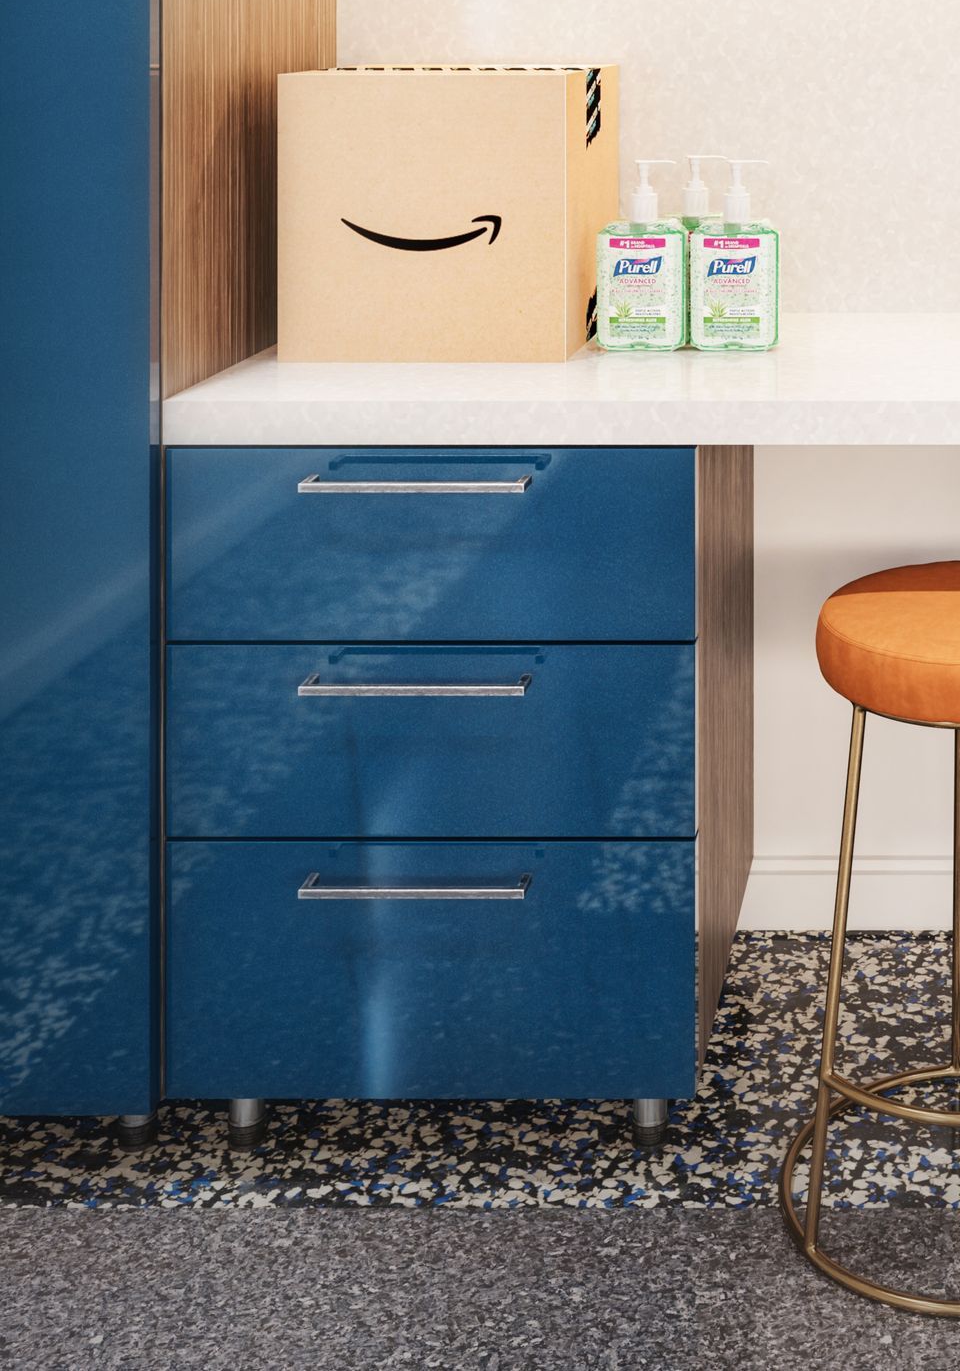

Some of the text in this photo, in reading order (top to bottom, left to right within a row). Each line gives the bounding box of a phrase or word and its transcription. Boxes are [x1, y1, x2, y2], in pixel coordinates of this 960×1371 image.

[620, 240, 630, 248] #1
[714, 240, 724, 248] #1
[619, 260, 658, 273] Purell
[713, 260, 752, 273] Purell
